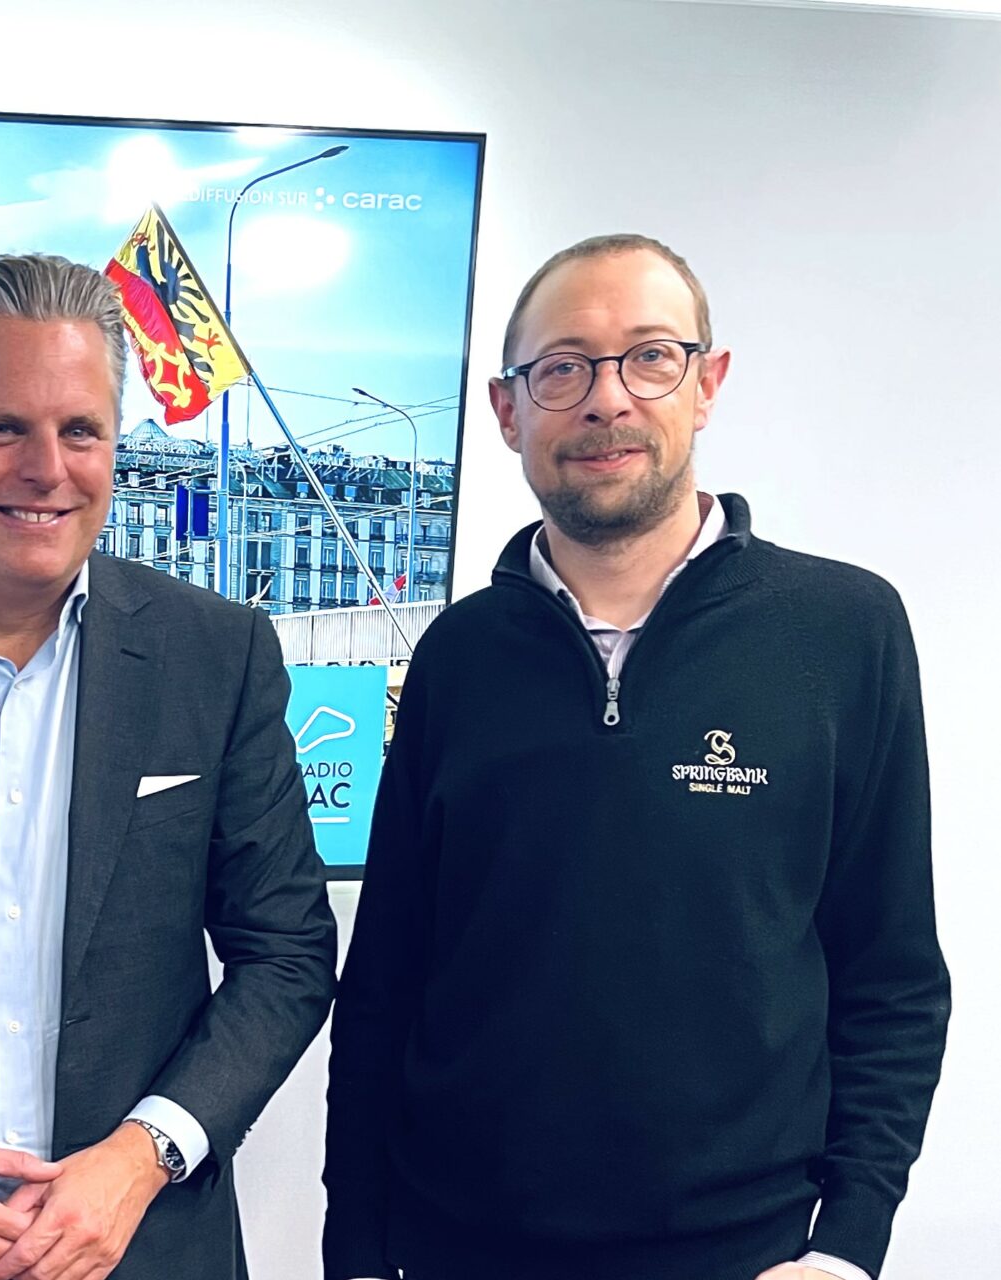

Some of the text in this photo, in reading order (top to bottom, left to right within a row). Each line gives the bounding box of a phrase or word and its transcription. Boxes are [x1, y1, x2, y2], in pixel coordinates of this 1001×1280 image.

[277, 191, 309, 207] SUR
[342, 191, 422, 211] carac
[672, 764, 769, 785] SPRINGBANK
[688, 782, 752, 795] SINGLE MALT
